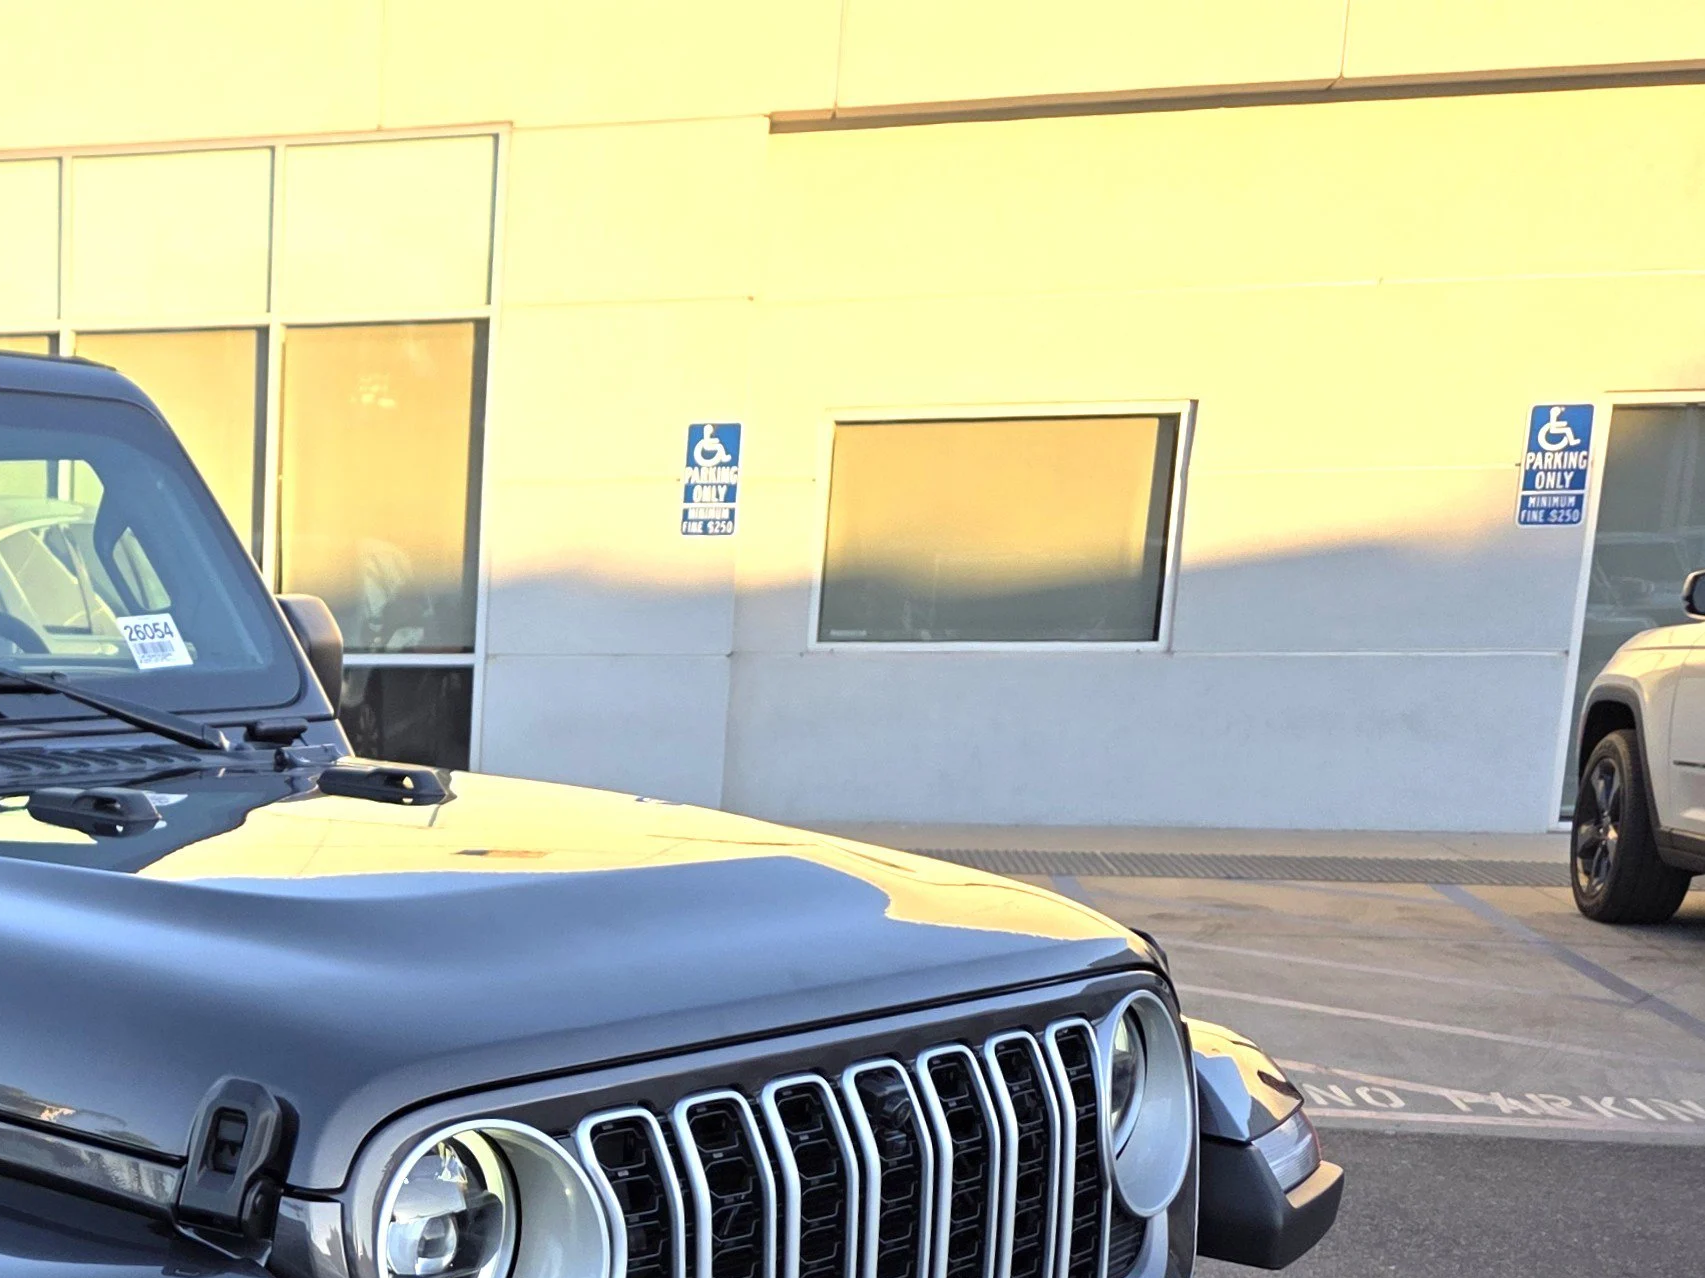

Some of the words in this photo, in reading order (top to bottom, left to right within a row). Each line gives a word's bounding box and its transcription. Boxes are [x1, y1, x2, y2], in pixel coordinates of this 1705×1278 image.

[1525, 451, 1588, 470] PARKING
[684, 465, 739, 485] PARKING
[1534, 471, 1575, 489] ONLY
[692, 484, 728, 503] ONLY
[1527, 496, 1576, 508] MINIMUM
[1520, 509, 1544, 522] FINE
[1548, 509, 1580, 522] $250
[682, 520, 703, 534] FINE
[707, 520, 733, 534] $250
[123, 621, 174, 642] 26054
[1300, 1082, 1406, 1109] NO
